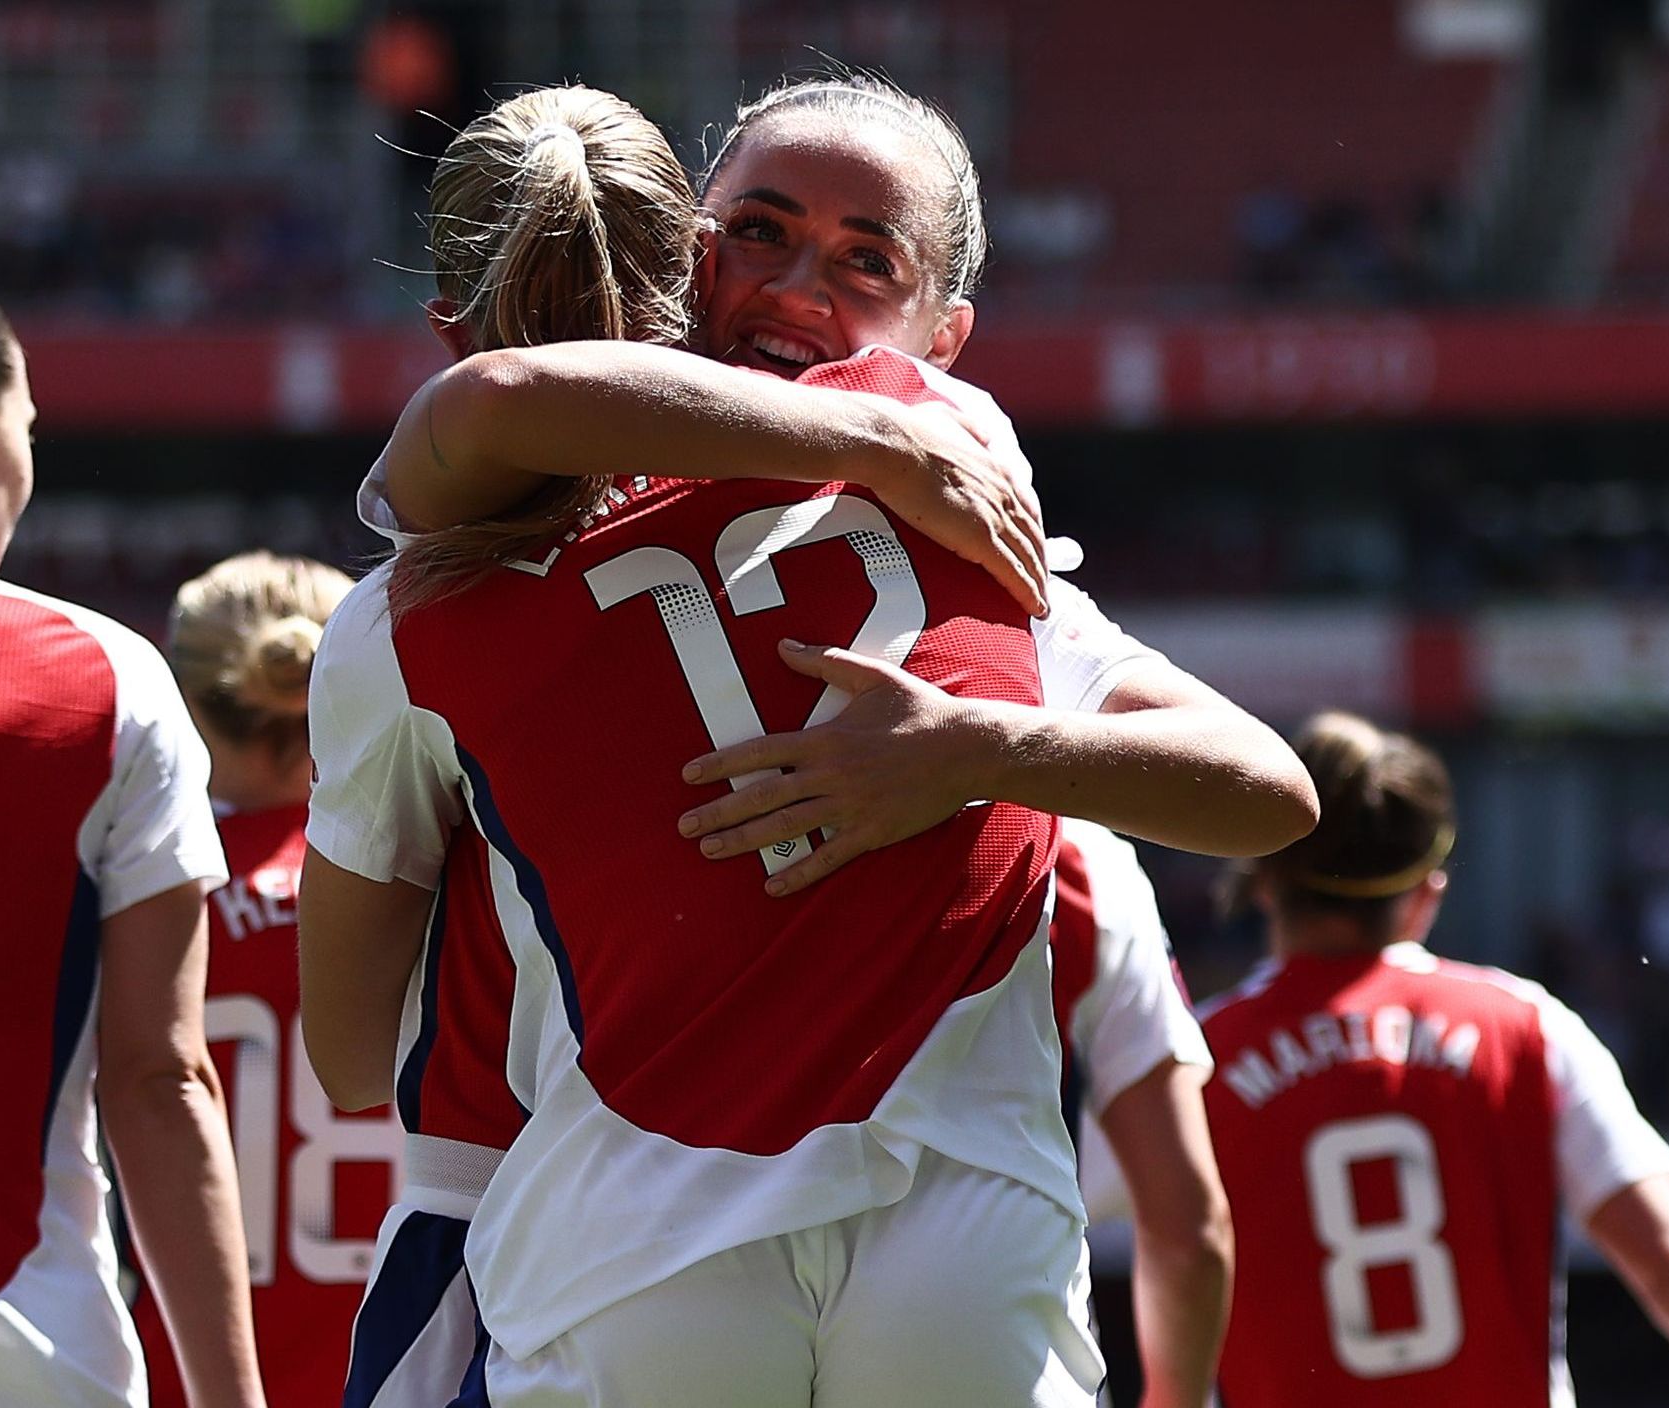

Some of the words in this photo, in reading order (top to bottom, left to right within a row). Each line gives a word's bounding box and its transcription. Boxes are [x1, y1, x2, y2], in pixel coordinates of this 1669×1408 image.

[212, 868, 300, 940] KE
[204, 993, 405, 1285] 18
[1303, 1112, 1464, 1379] 8
